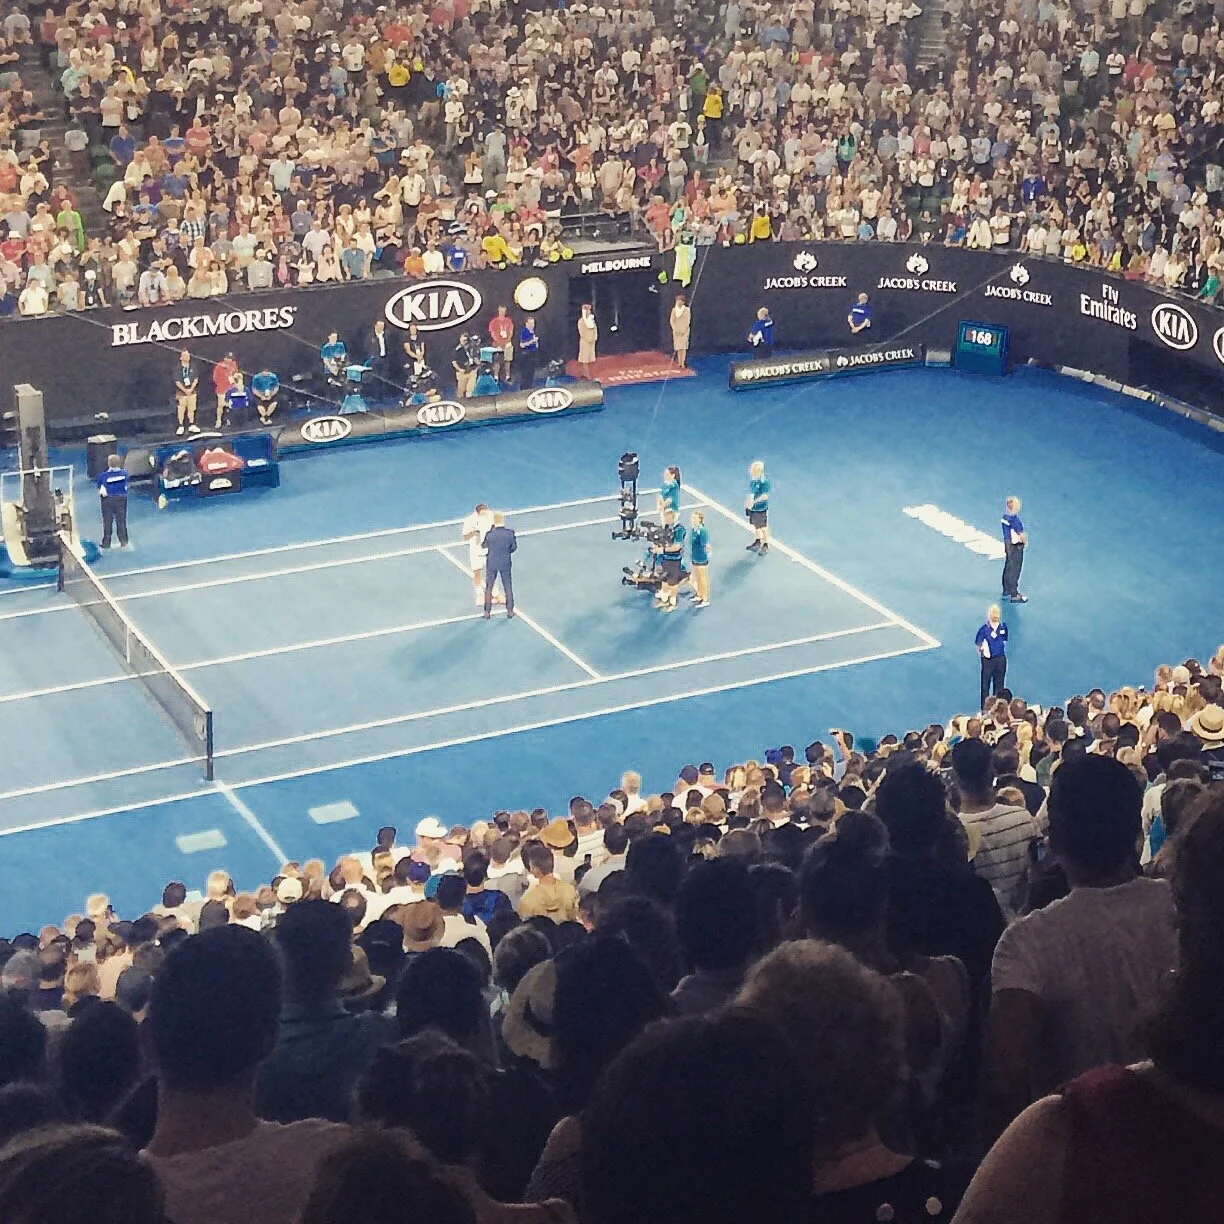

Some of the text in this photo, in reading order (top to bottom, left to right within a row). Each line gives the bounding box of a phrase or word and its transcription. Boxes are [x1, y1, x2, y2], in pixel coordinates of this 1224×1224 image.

[581, 256, 651, 274] MELBOURNE
[763, 276, 847, 289] JACOB'S CREEK
[877, 277, 957, 292] JACOB'S CREEK
[984, 285, 1053, 306] JACOB'S CREEK
[1102, 283, 1119, 305] Fly
[402, 290, 465, 322] KIA
[1080, 293, 1137, 330] Emirates
[111, 306, 295, 347] BLACKMORES
[1159, 310, 1189, 343] KIA
[971, 329, 992, 345] 168
[885, 349, 914, 361] CREEK
[792, 360, 822, 374] CREEK
[535, 392, 565, 408] KIA
[425, 406, 458, 423] KIA
[310, 420, 343, 438] KIA
